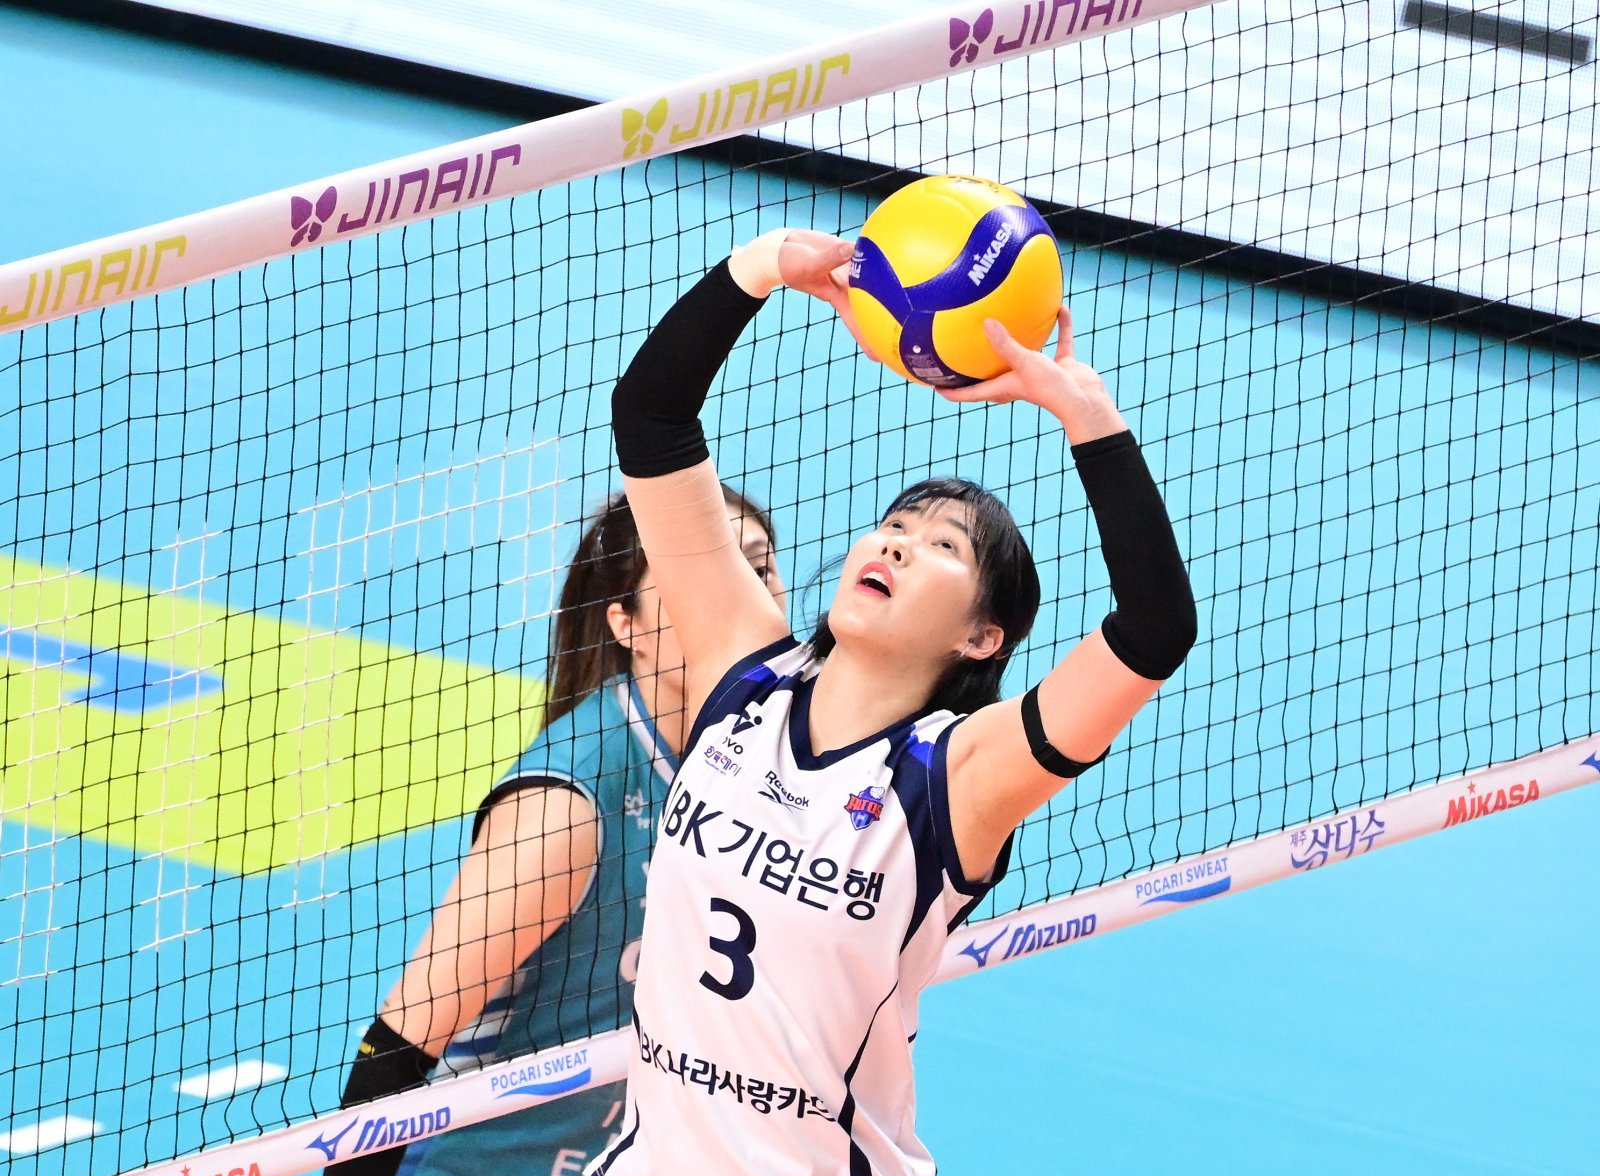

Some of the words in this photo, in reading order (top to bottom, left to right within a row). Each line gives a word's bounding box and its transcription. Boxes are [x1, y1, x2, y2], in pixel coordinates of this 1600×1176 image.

[669, 53, 851, 144] JINAIR
[337, 143, 522, 233] JINAIR
[0, 235, 187, 326] JINAIR
[968, 222, 1013, 287] MIKASA
[765, 770, 810, 807] Reebok
[1442, 779, 1540, 829] MIKASA
[718, 818, 885, 921] 기업은행
[1136, 874, 1183, 898] POCARI
[1187, 857, 1229, 883] SWEAT
[698, 897, 757, 1001] 3
[1001, 914, 1097, 960] MIZUNO
[491, 1067, 541, 1092] POCARI
[544, 1049, 589, 1076] SWEAT
[352, 1106, 452, 1154] MIZUNO
